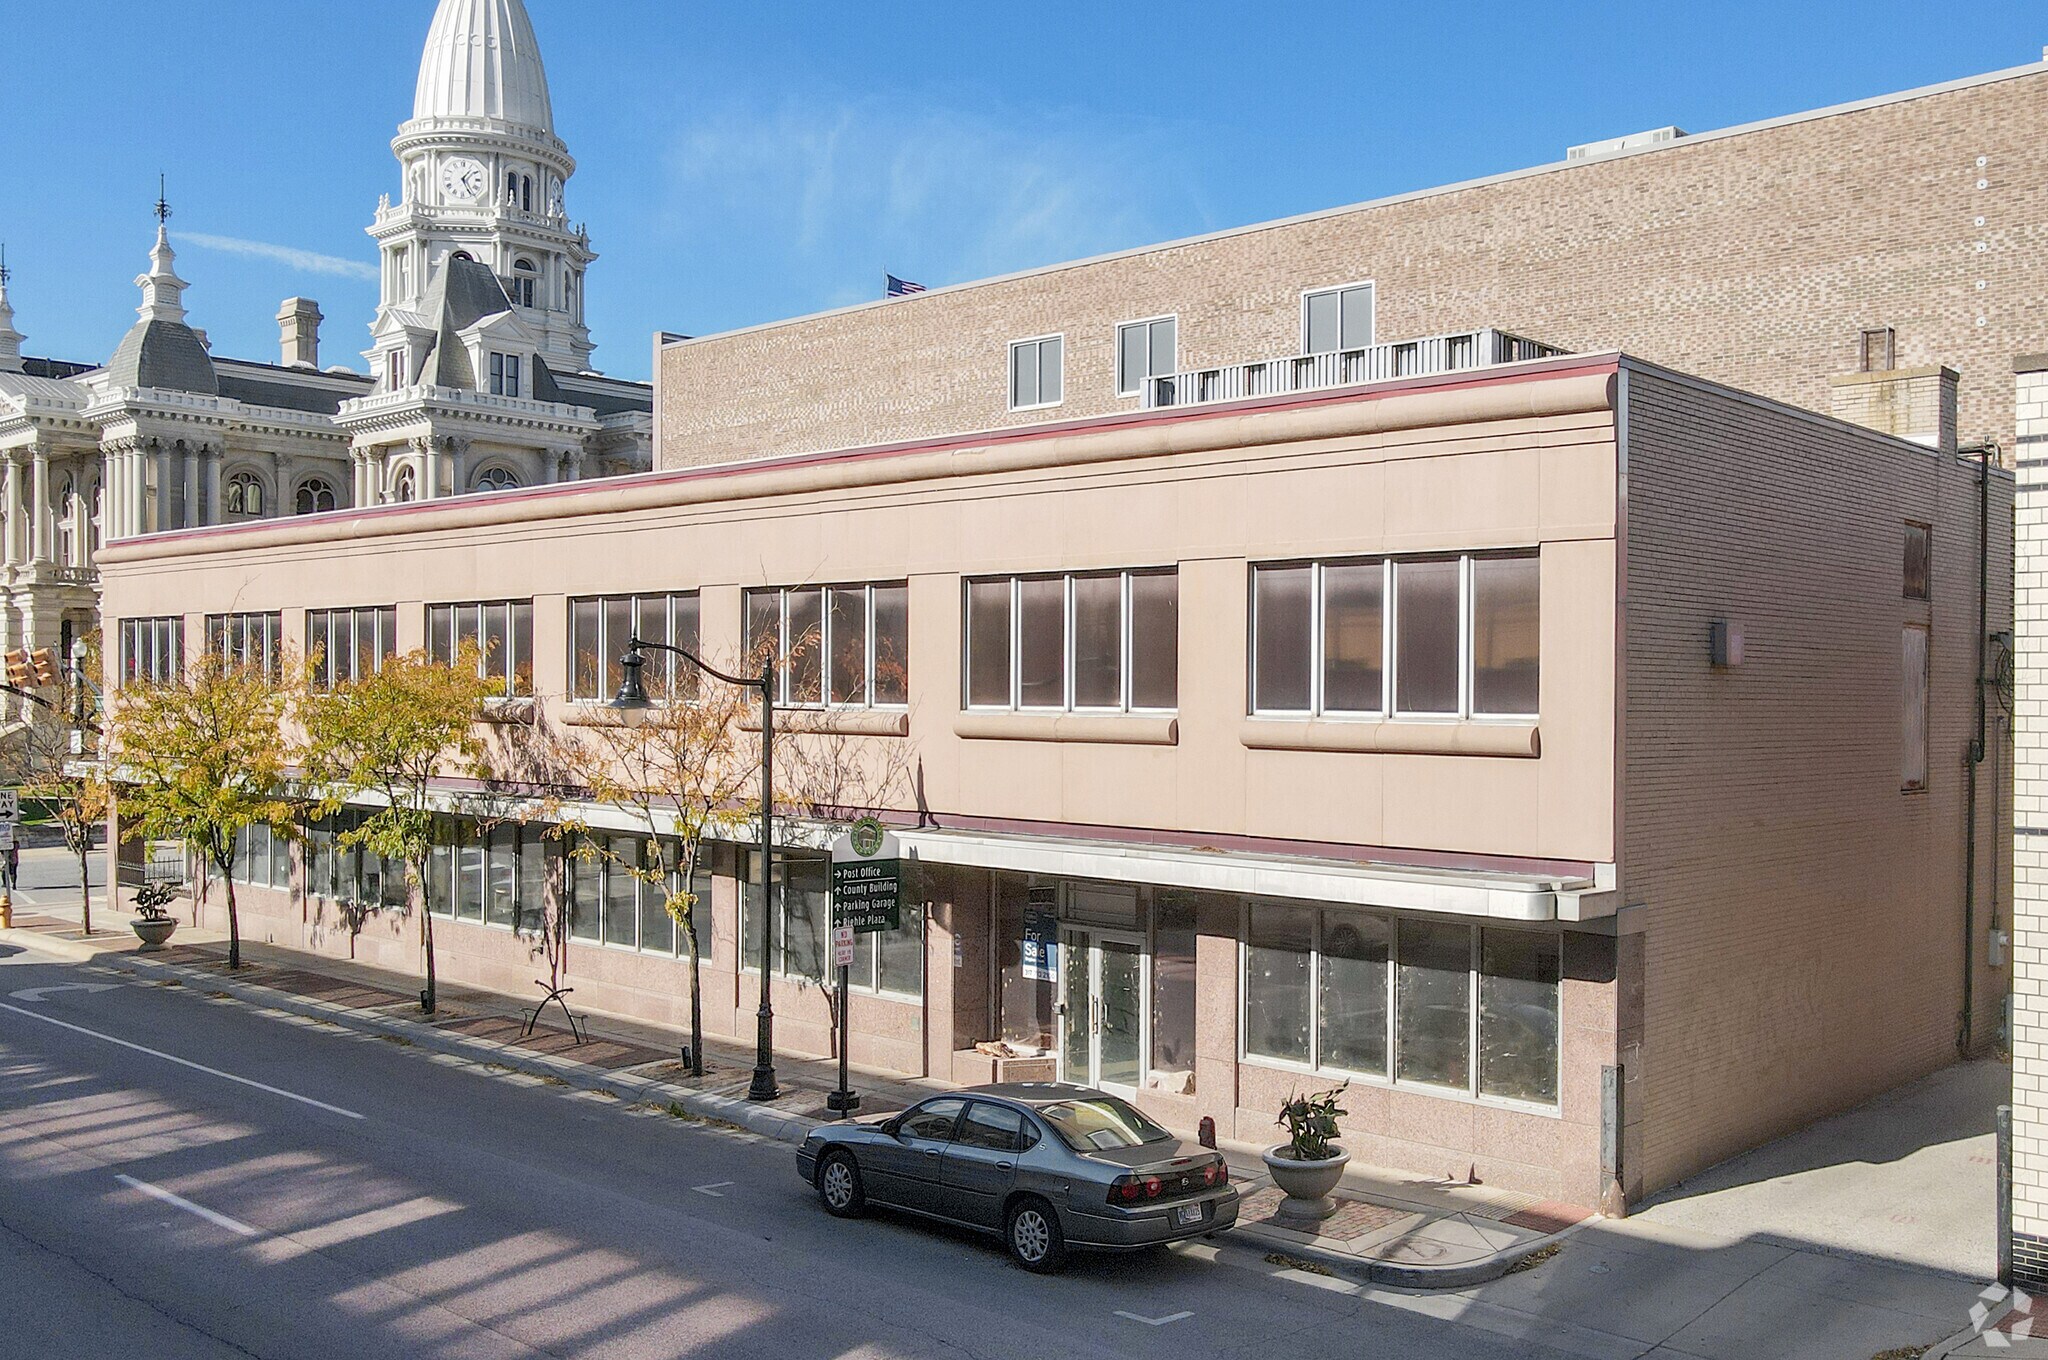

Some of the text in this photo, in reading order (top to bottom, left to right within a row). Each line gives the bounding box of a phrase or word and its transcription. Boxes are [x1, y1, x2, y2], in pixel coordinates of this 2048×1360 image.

[0, 792, 13, 800] NE
[0, 800, 14, 808] AY
[843, 866, 881, 879] Post Office
[843, 881, 897, 896] County Building
[843, 898, 896, 912] Parking Garage
[867, 914, 885, 925] Plaza
[1025, 928, 1041, 942] For
